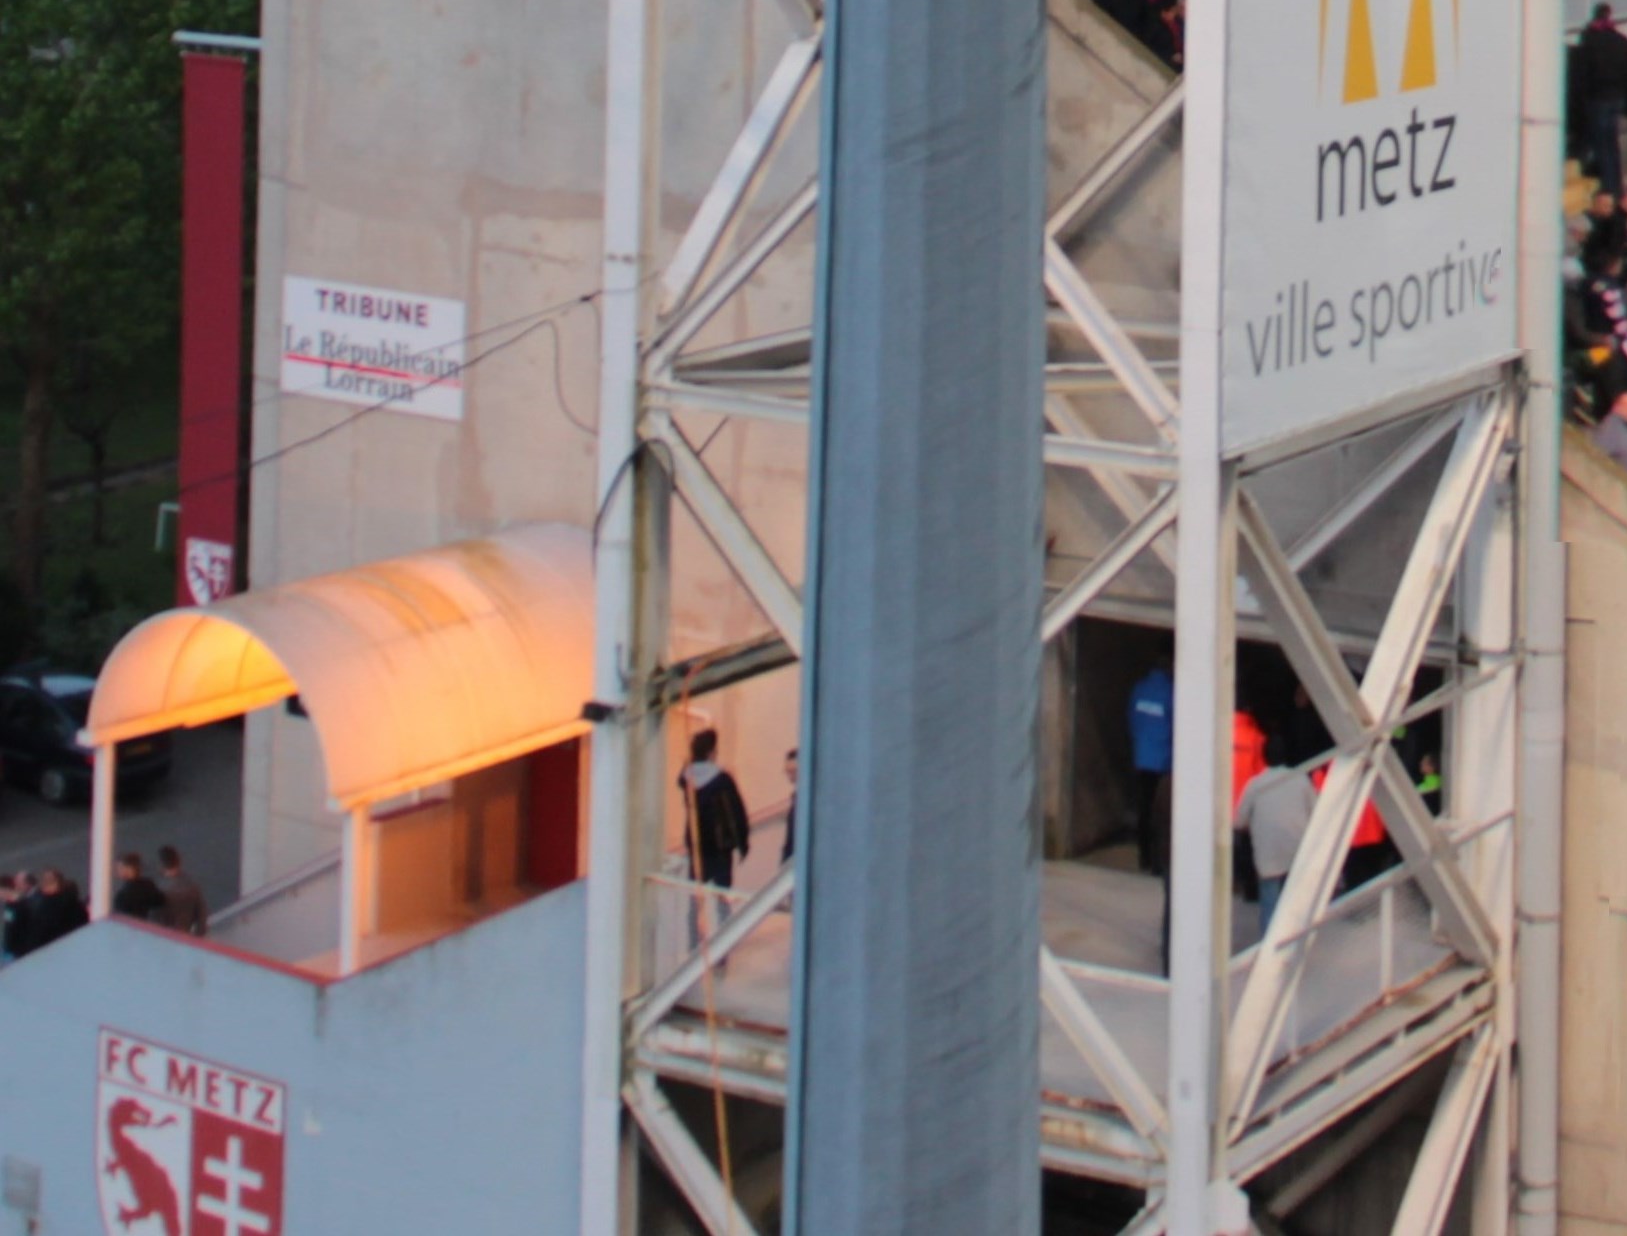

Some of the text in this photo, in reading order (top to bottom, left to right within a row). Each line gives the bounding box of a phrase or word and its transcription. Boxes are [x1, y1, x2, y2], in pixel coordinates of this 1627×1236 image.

[1316, 107, 1458, 224] metz
[315, 288, 428, 327] TRIBUNE
[1246, 239, 1502, 377] ville sportive
[284, 325, 460, 378] Le Républicain
[325, 364, 414, 402] Lorrain
[107, 1038, 277, 1126] FC METZ
